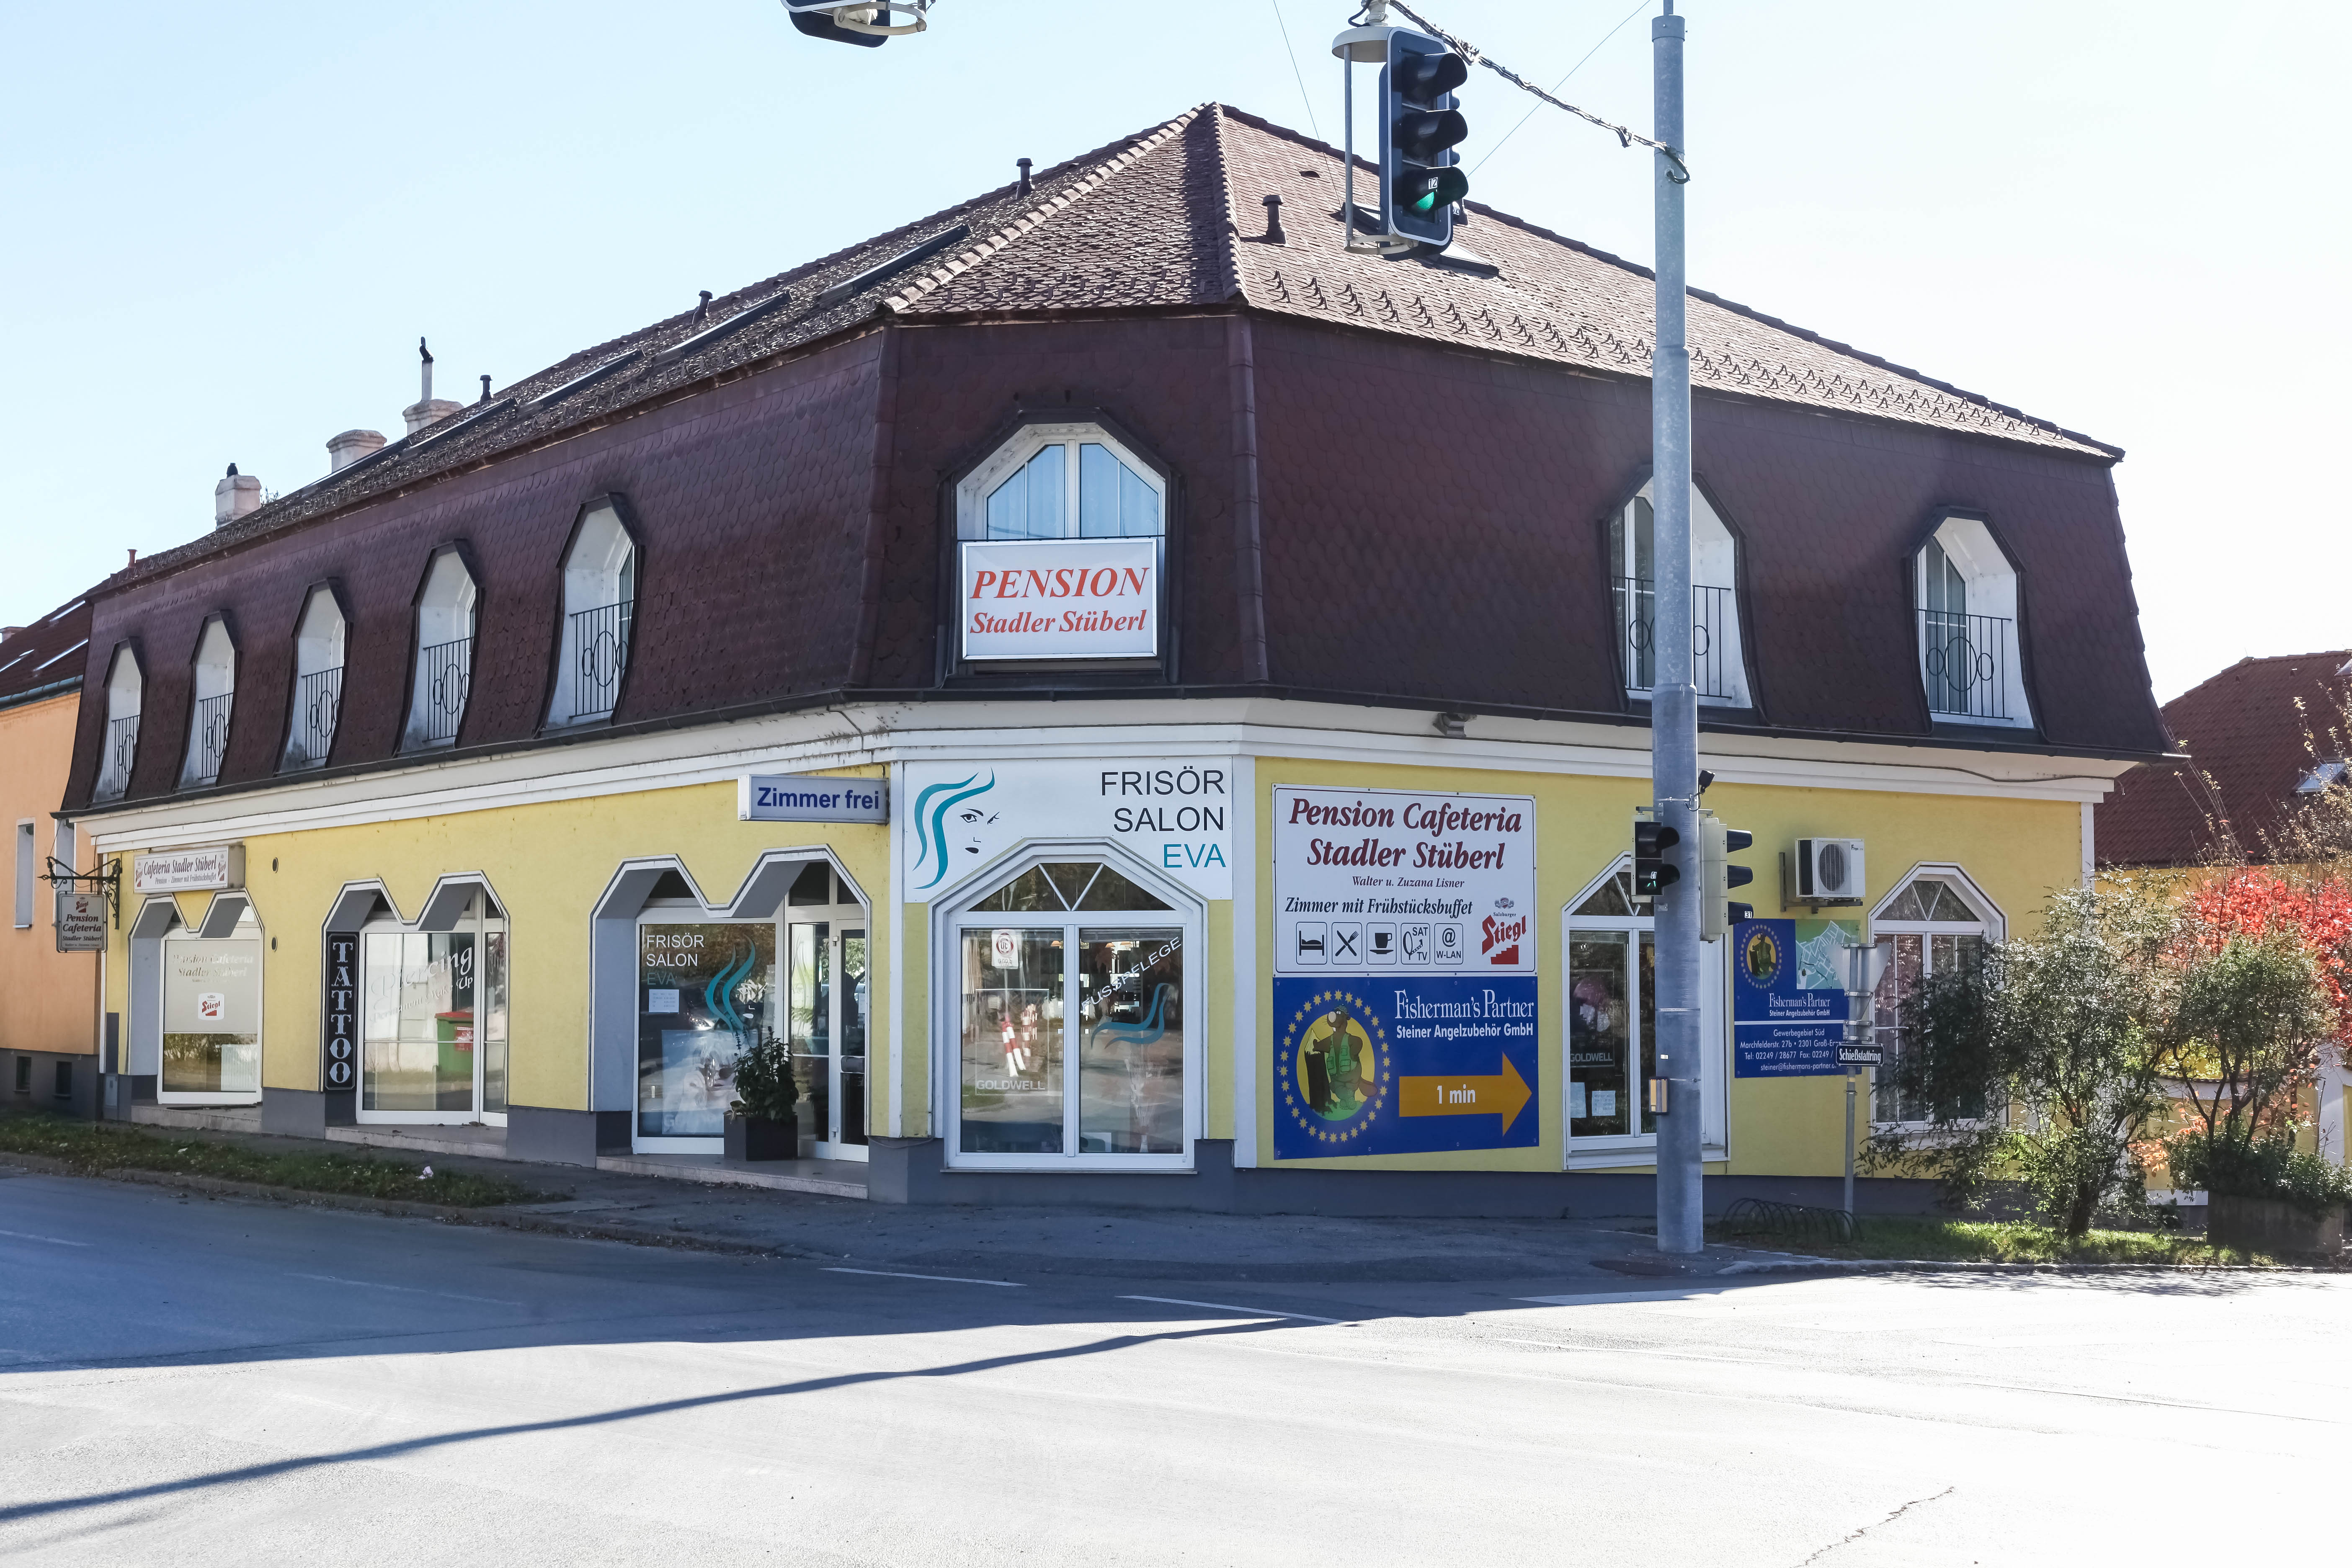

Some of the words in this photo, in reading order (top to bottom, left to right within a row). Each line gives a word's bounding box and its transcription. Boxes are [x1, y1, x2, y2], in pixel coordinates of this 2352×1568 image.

[1429, 178, 1437, 188] 12
[970, 567, 1150, 599] PENSION
[970, 611, 1055, 634] Stadler
[1058, 609, 1147, 632] Stüberl
[1101, 766, 1225, 796] FRISÖR
[757, 787, 840, 808] Zimmer
[845, 789, 879, 809] frei
[1114, 807, 1223, 832] SALON
[1288, 798, 1395, 828] Pension
[1403, 802, 1522, 837] Cafeteria
[1164, 843, 1226, 868] EVA
[1307, 838, 1406, 867] Stadler
[1413, 841, 1506, 869] Stüberl
[144, 860, 170, 879] Cafeteria
[172, 858, 193, 874] Stadler
[194, 855, 217, 872] Stüberl
[1352, 876, 1384, 887] Walter
[1397, 877, 1433, 887] Zuzana
[1435, 878, 1465, 888] Lisner
[76, 901, 89, 910] Stiegl
[1284, 897, 1338, 913] Zimmer
[1342, 898, 1364, 913] mit
[1367, 898, 1473, 919] Frühstücksbuffet
[63, 923, 101, 934] Cafeteria
[1412, 927, 1428, 936] SAT
[1482, 915, 1526, 955] Stiegl
[647, 932, 704, 948] FRISÖR
[646, 953, 698, 967] SALON
[1417, 952, 1427, 961] TV
[1436, 950, 1462, 959] W-LAN
[647, 972, 676, 985] EVA
[1081, 936, 1181, 1011] FUSSPFLEGE
[456, 976, 473, 990] Up
[202, 1001, 220, 1013] Stiegl
[1394, 989, 1481, 1019] Fisherman's
[1483, 989, 1534, 1017] Partner
[1769, 993, 1807, 1007] Fisherman's
[1808, 993, 1830, 1007] Partner
[329, 942, 353, 1083] TATTOO
[1786, 1009, 1816, 1018] Angelzubehör
[1397, 1025, 1431, 1039] Steiner
[1434, 1023, 1501, 1041] Angelzubehör
[1504, 1023, 1533, 1036] GmbH
[1773, 1029, 1813, 1038] Gewerbegebiet
[1570, 1052, 1612, 1062] GOLDWELL
[1839, 1048, 1881, 1063] Schießstattring
[976, 1080, 1046, 1091] GOLDWELL
[1437, 1085, 1442, 1104] 1
[1449, 1084, 1475, 1104] min
